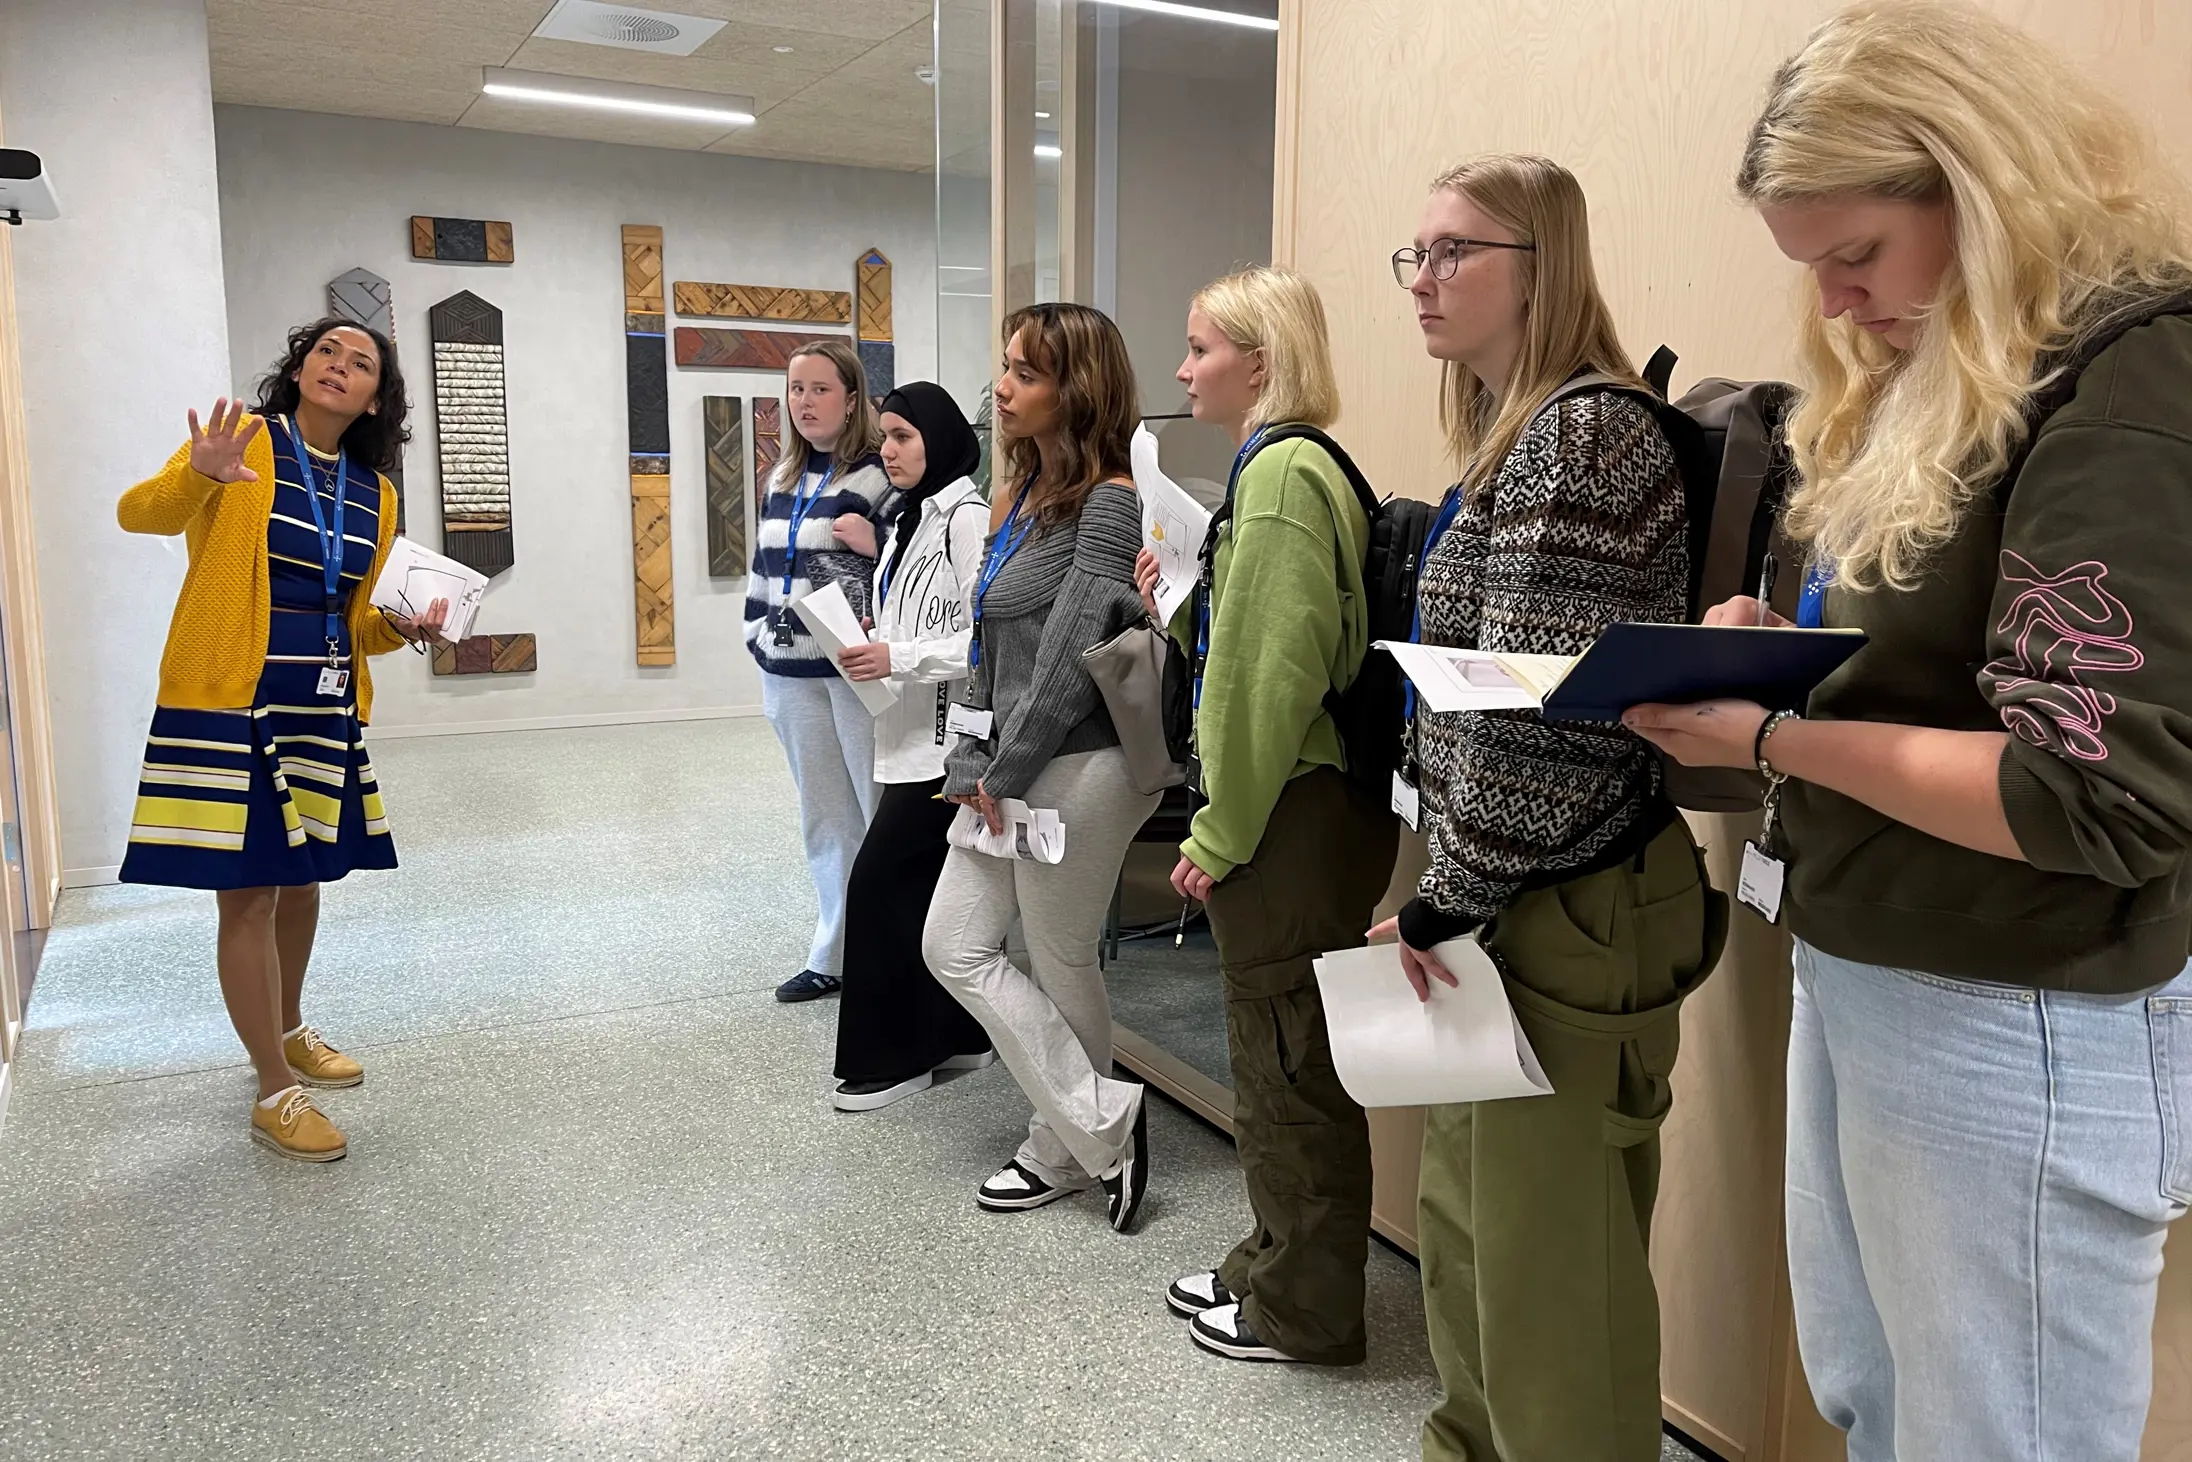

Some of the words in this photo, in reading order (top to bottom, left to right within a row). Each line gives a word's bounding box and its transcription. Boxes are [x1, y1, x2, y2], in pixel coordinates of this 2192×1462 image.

[898, 546, 961, 637] More
[937, 681, 947, 706] OVE
[936, 710, 944, 743] LOVE
